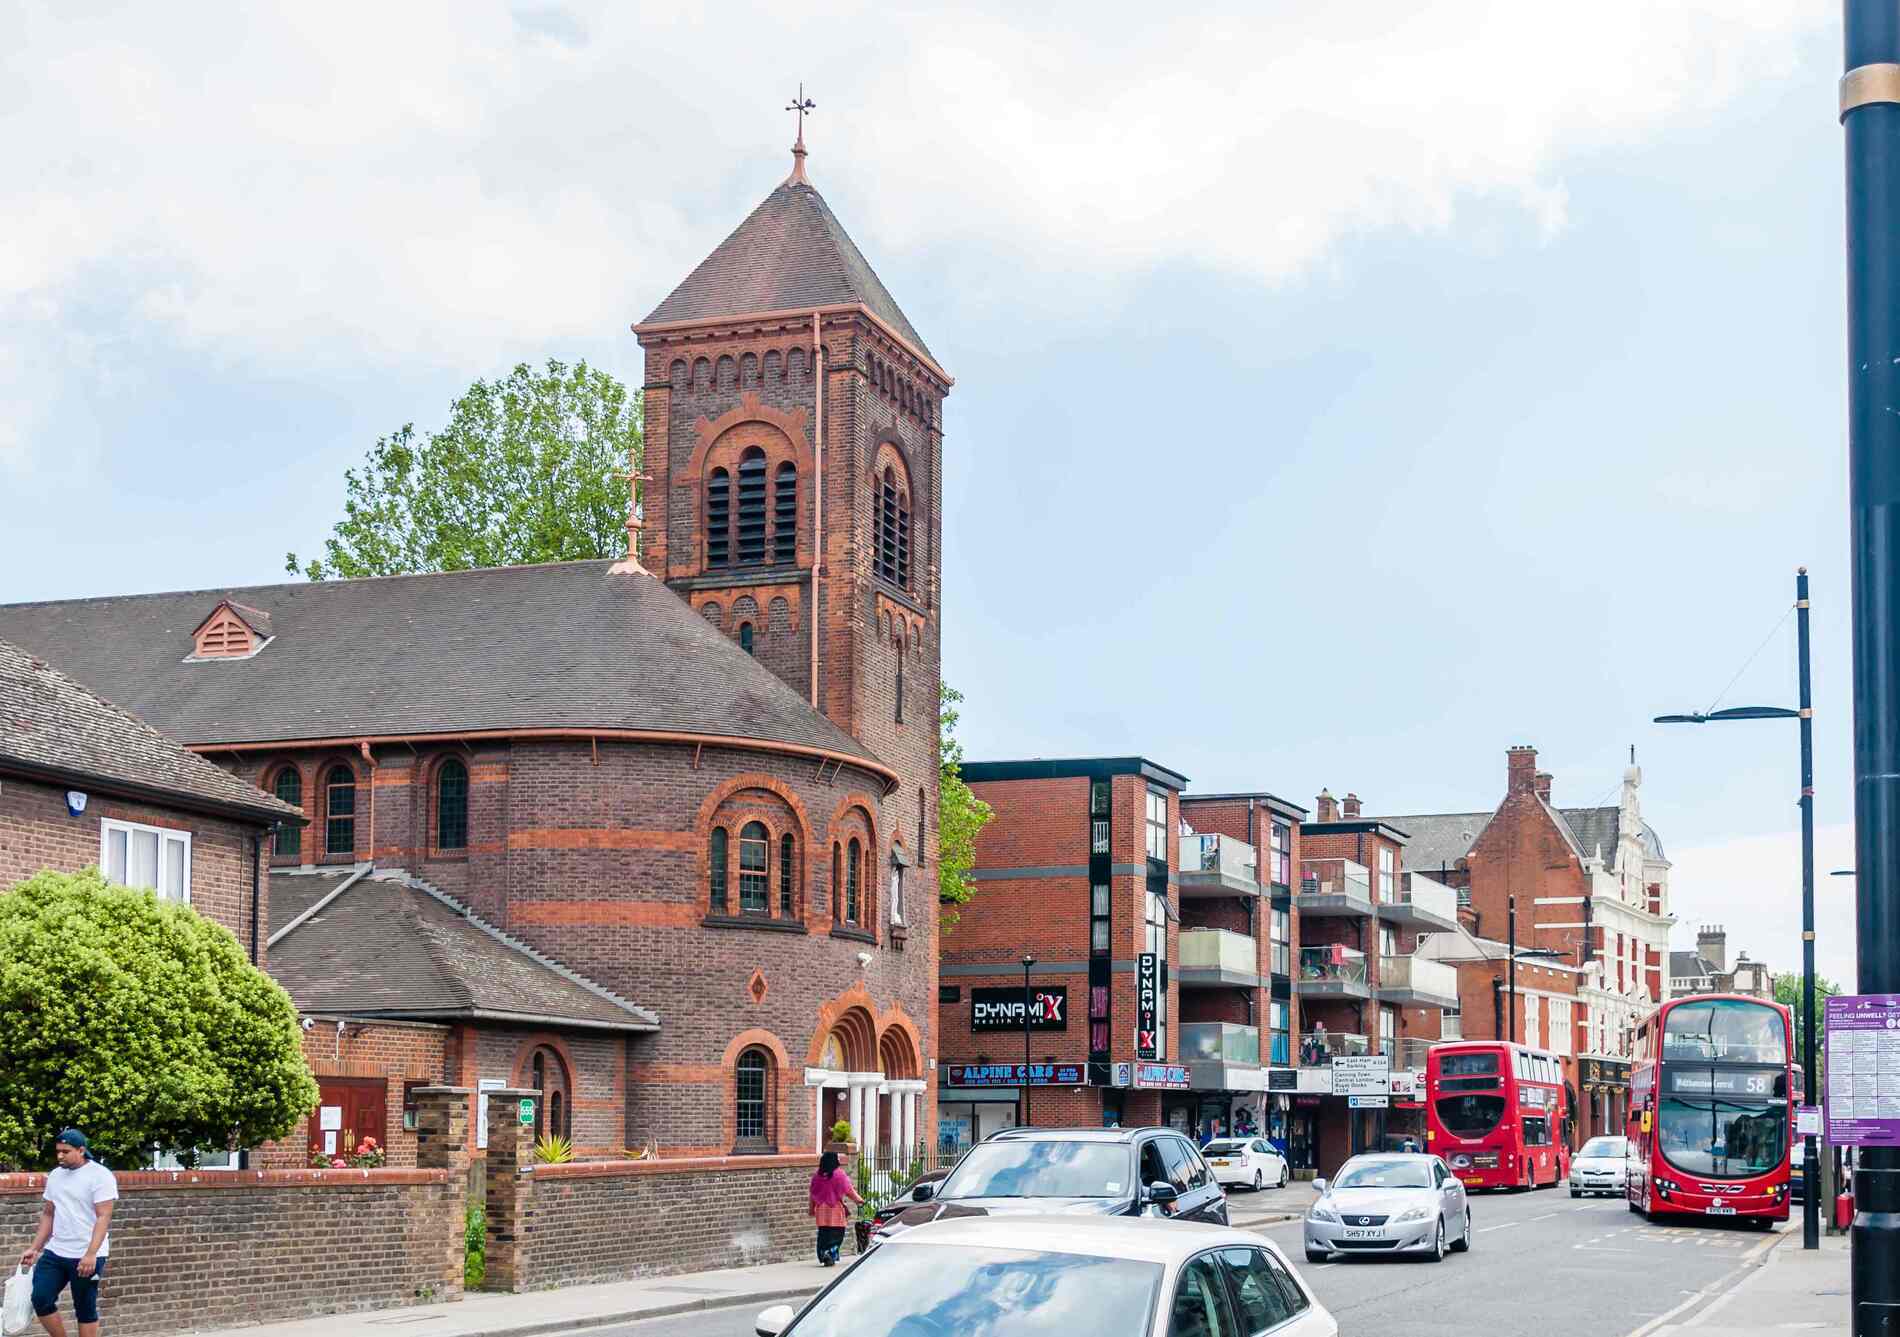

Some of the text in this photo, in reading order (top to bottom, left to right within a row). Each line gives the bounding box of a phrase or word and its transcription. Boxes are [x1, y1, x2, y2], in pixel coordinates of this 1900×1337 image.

[963, 1066, 1012, 1079] ALPINE
[1017, 1066, 1054, 1078] CARS
[1746, 1077, 1766, 1093] 58
